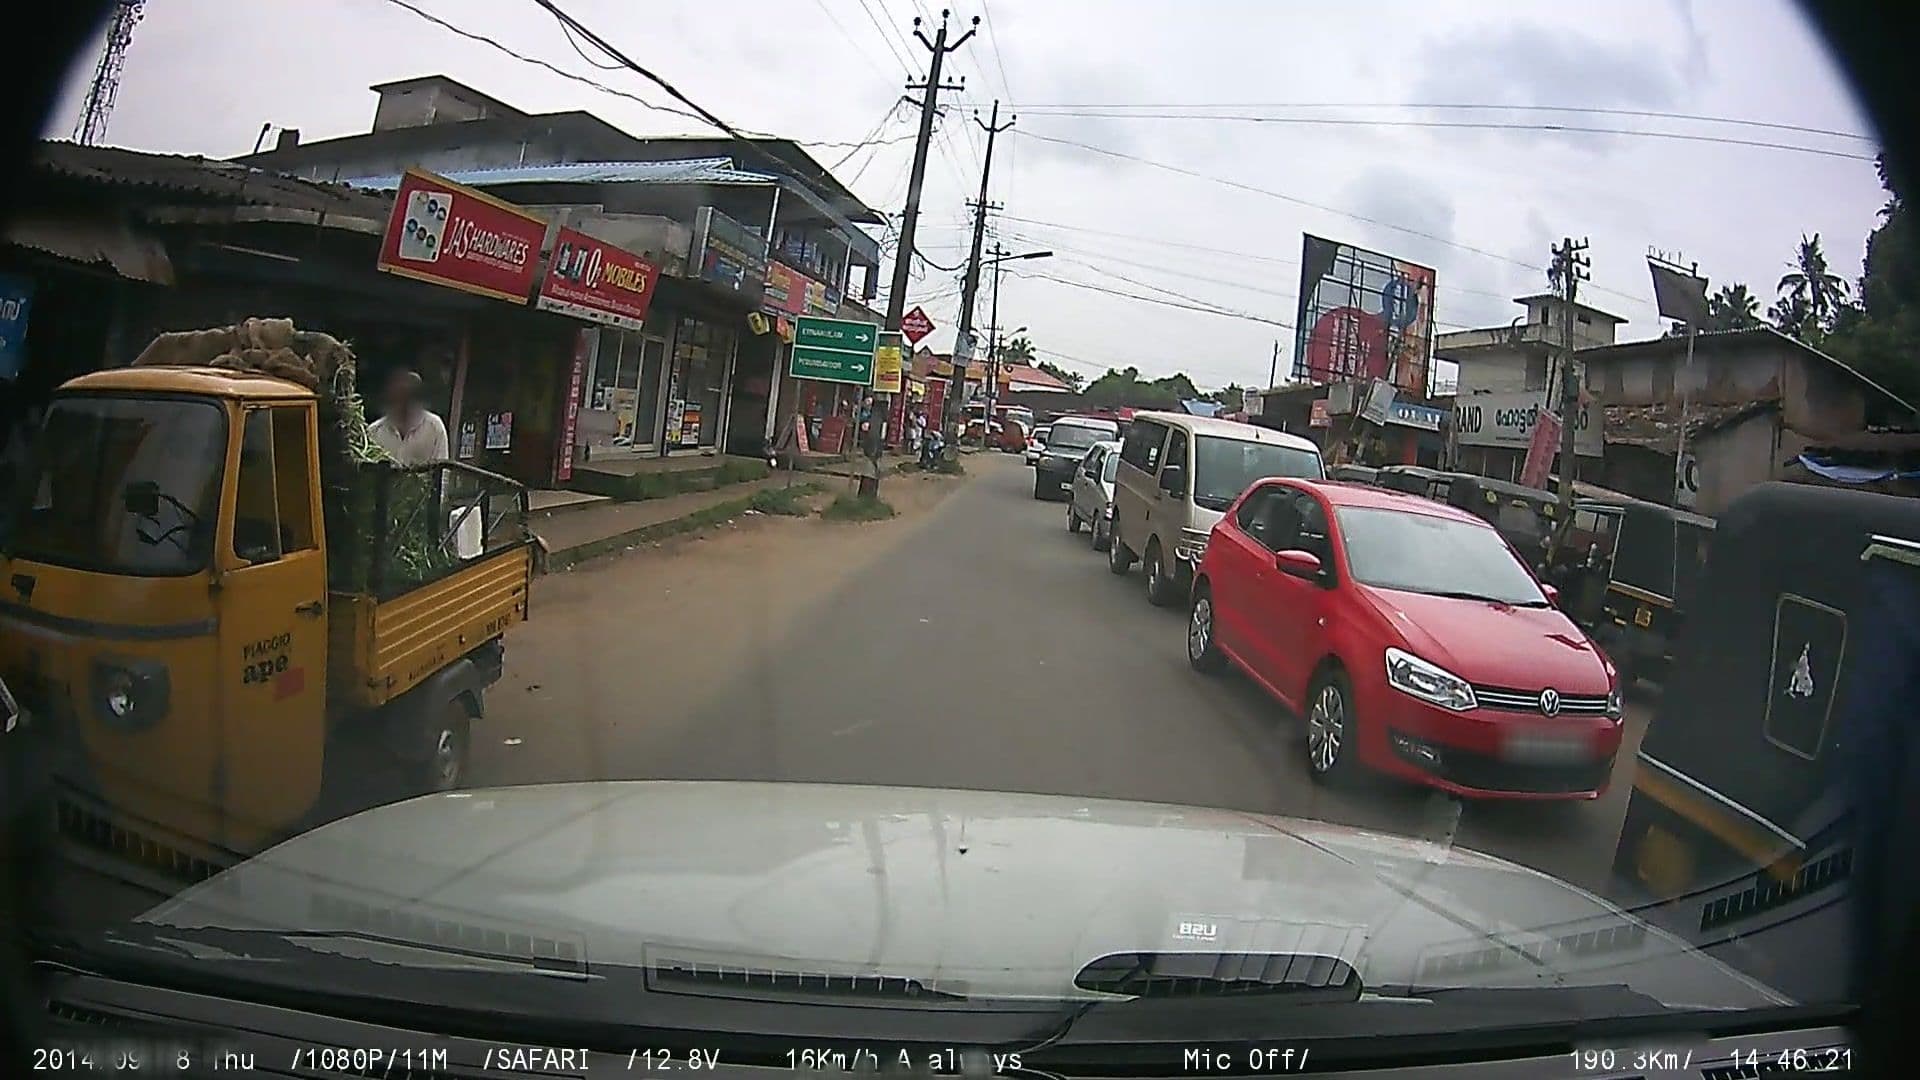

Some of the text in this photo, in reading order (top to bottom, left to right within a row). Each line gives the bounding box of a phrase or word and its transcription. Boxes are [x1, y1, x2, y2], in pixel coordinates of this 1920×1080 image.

[443, 217, 474, 259] JAS
[602, 262, 648, 293] MOBILES
[243, 632, 291, 660] PIAGGIO
[243, 655, 289, 684] ape
